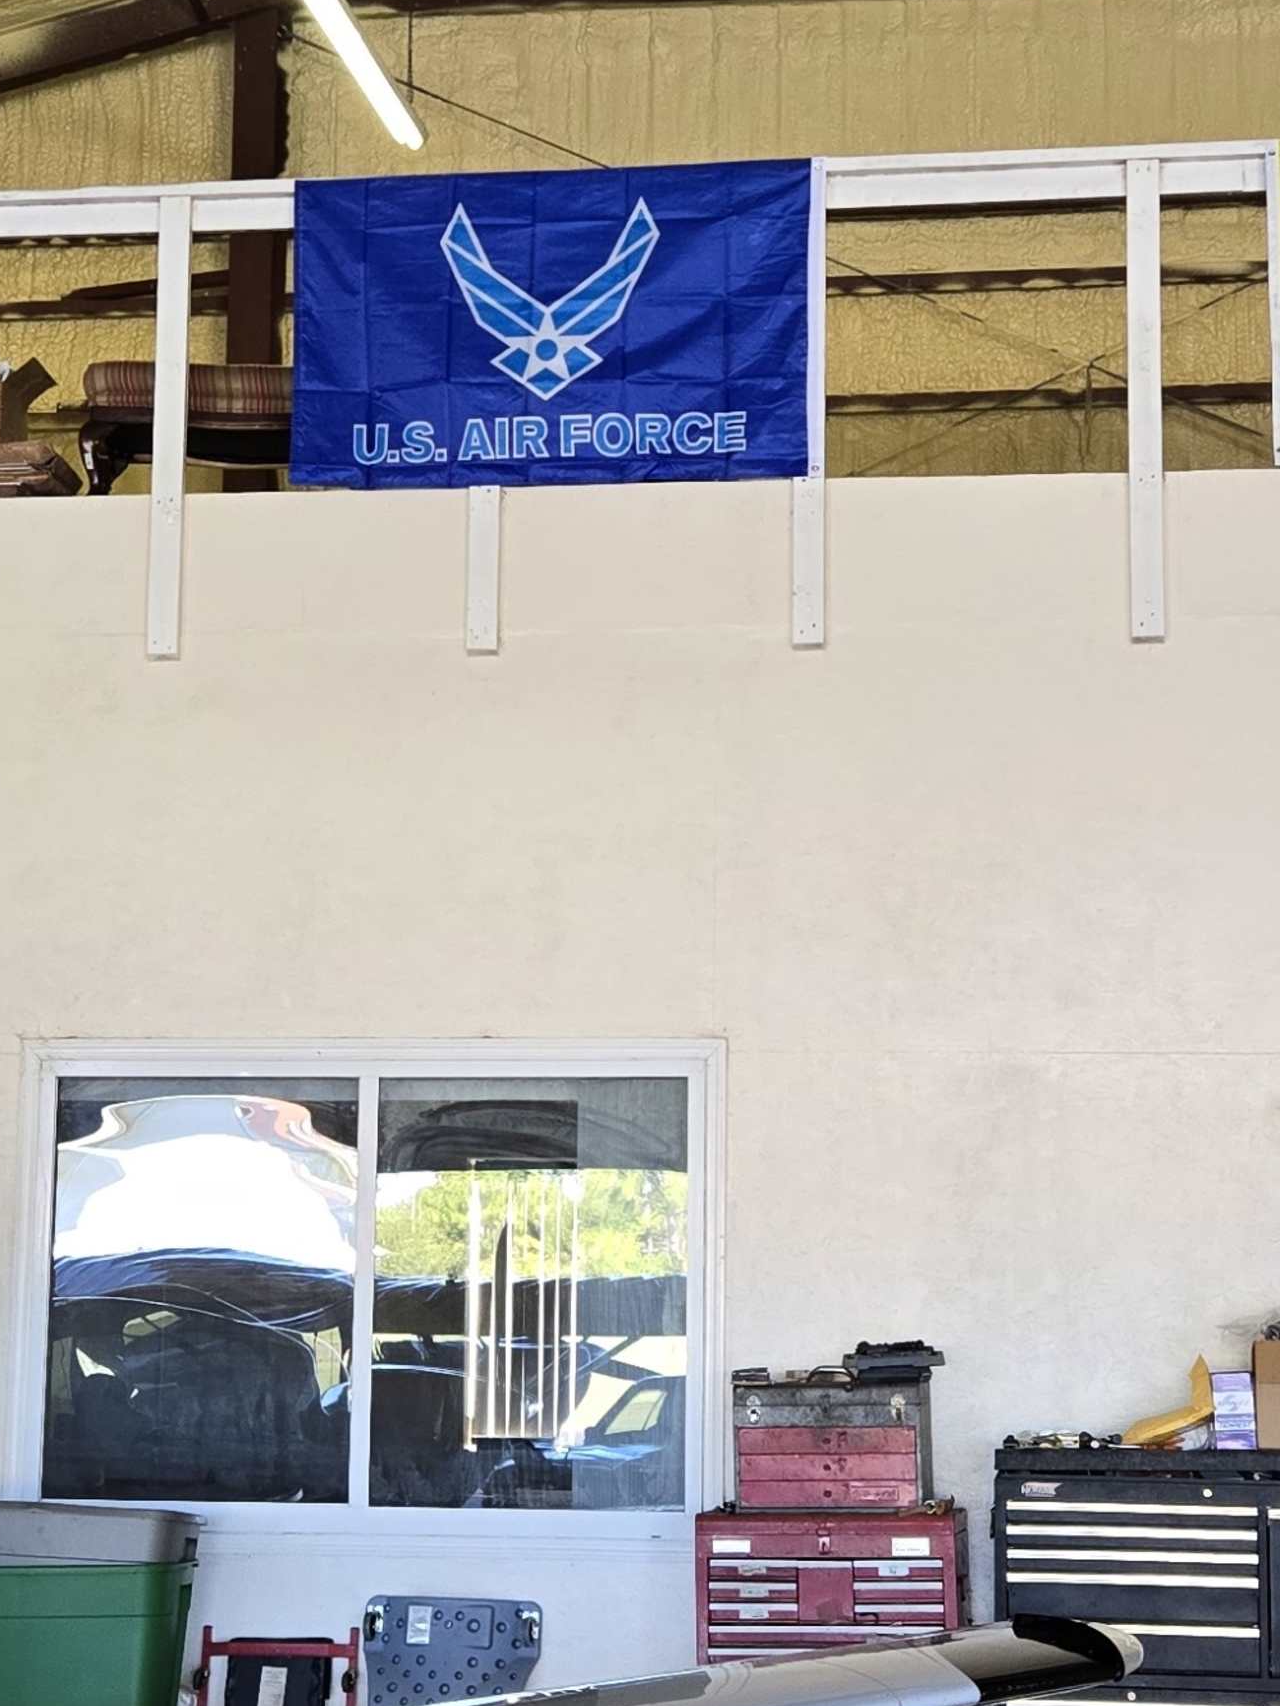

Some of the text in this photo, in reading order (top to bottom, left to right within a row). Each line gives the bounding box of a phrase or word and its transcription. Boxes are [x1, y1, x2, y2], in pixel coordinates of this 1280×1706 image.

[353, 411, 747, 465] U.S. AIR FORCE
